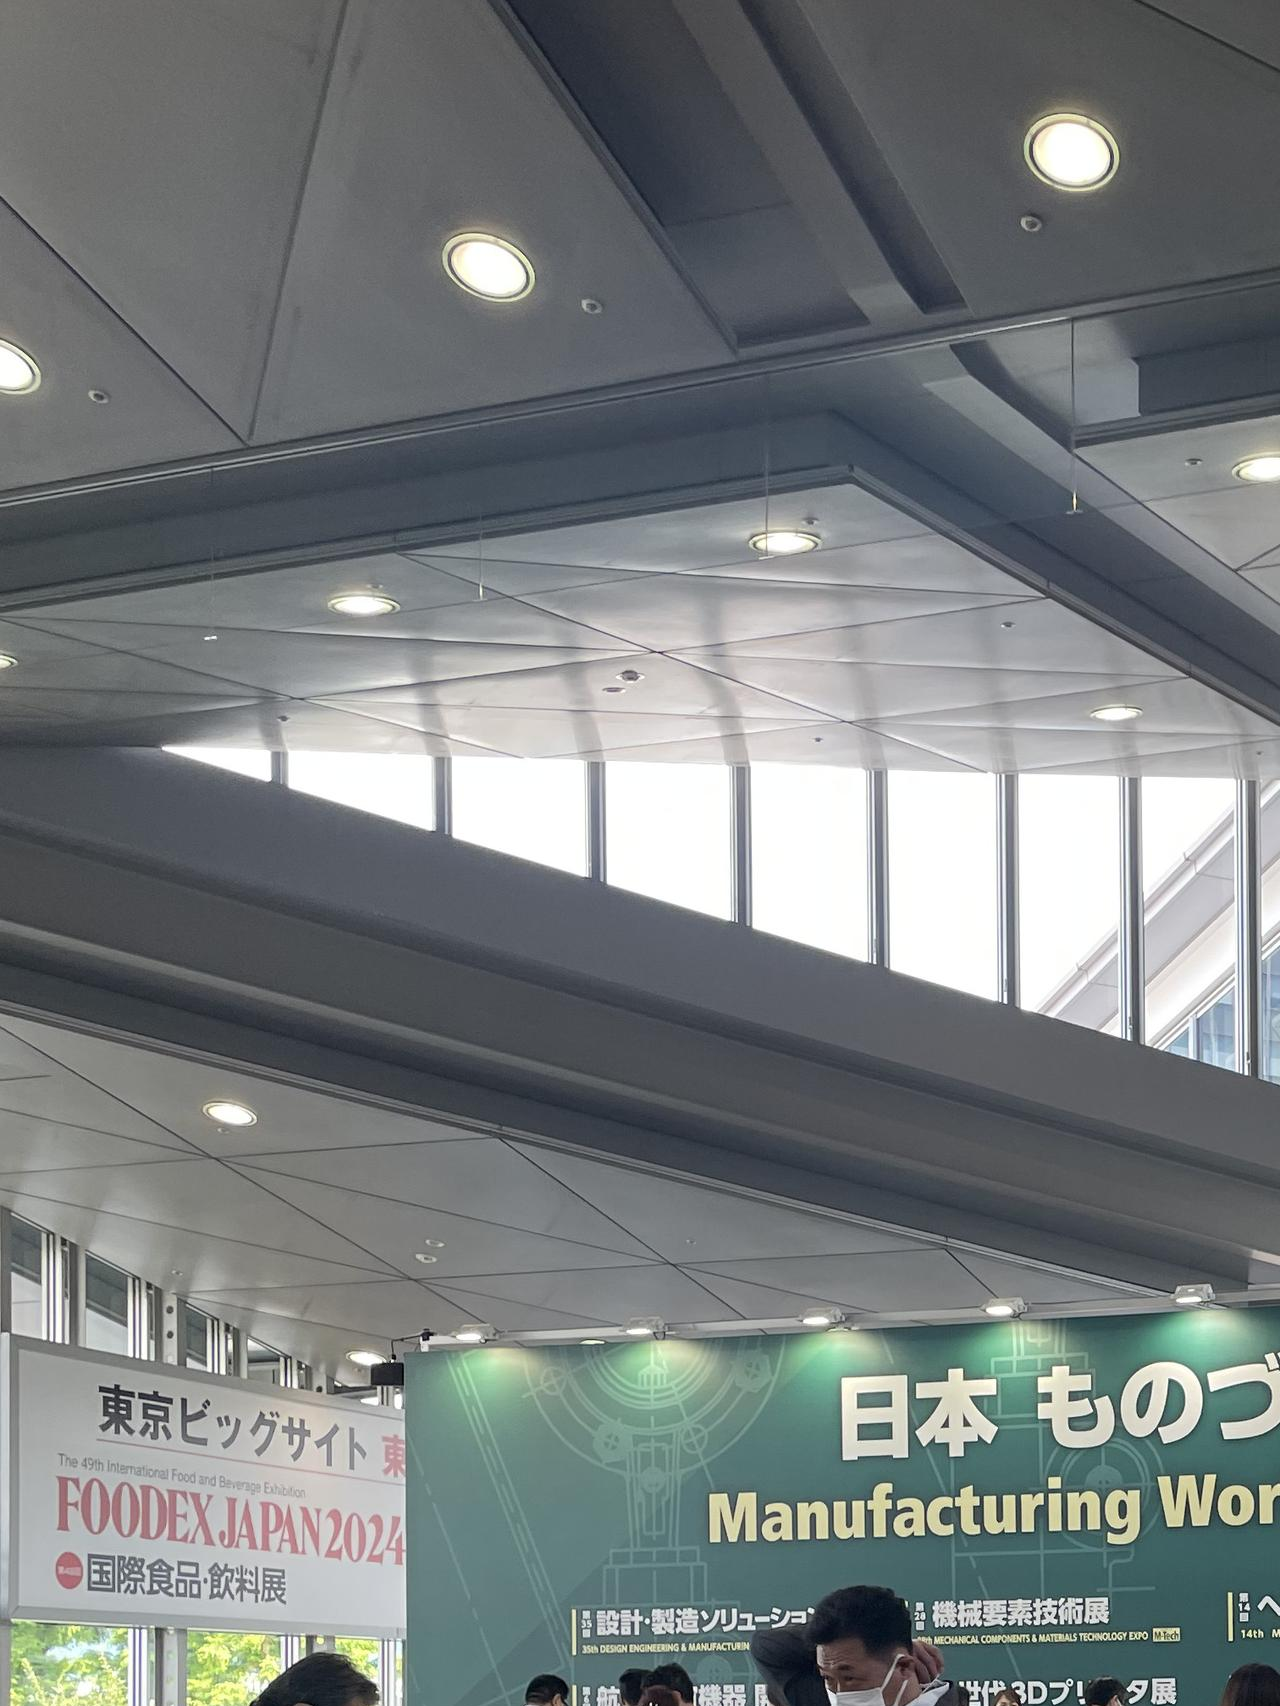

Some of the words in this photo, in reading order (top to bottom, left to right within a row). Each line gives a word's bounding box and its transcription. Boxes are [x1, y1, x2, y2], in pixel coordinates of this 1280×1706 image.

[98, 1384, 367, 1471] 東京ビッグサイト
[840, 1367, 998, 1462] 日本
[57, 1453, 79, 1469] The
[81, 1457, 104, 1472] 49th
[106, 1461, 169, 1481] International
[171, 1468, 196, 1484] Food
[199, 1474, 217, 1487] and
[219, 1476, 262, 1496] Beverage
[264, 1481, 306, 1498] Exhibition
[56, 1475, 215, 1548] FOODEX
[219, 1495, 322, 1557] JAPAN
[324, 1508, 406, 1565] 2024
[708, 1480, 1142, 1546] Manufacturing
[596, 1606, 815, 1637] 設計・製造ソリューショ
[932, 1597, 1110, 1628] 機械要素技術展
[600, 1644, 627, 1654] DESIGN
[629, 1643, 679, 1653] ENGINEERING
[681, 1643, 687, 1651] &
[688, 1641, 750, 1652] MANUFACTURIN
[934, 1634, 979, 1644] MECHANICAL
[980, 1634, 1030, 1643] COMPONENTS
[1031, 1634, 1037, 1643] &
[1038, 1633, 1077, 1643] MATERIALS
[1079, 1632, 1127, 1642] TECHNOLOGY
[1129, 1631, 1149, 1641] EXPO
[1241, 1629, 1264, 1639] 14th
